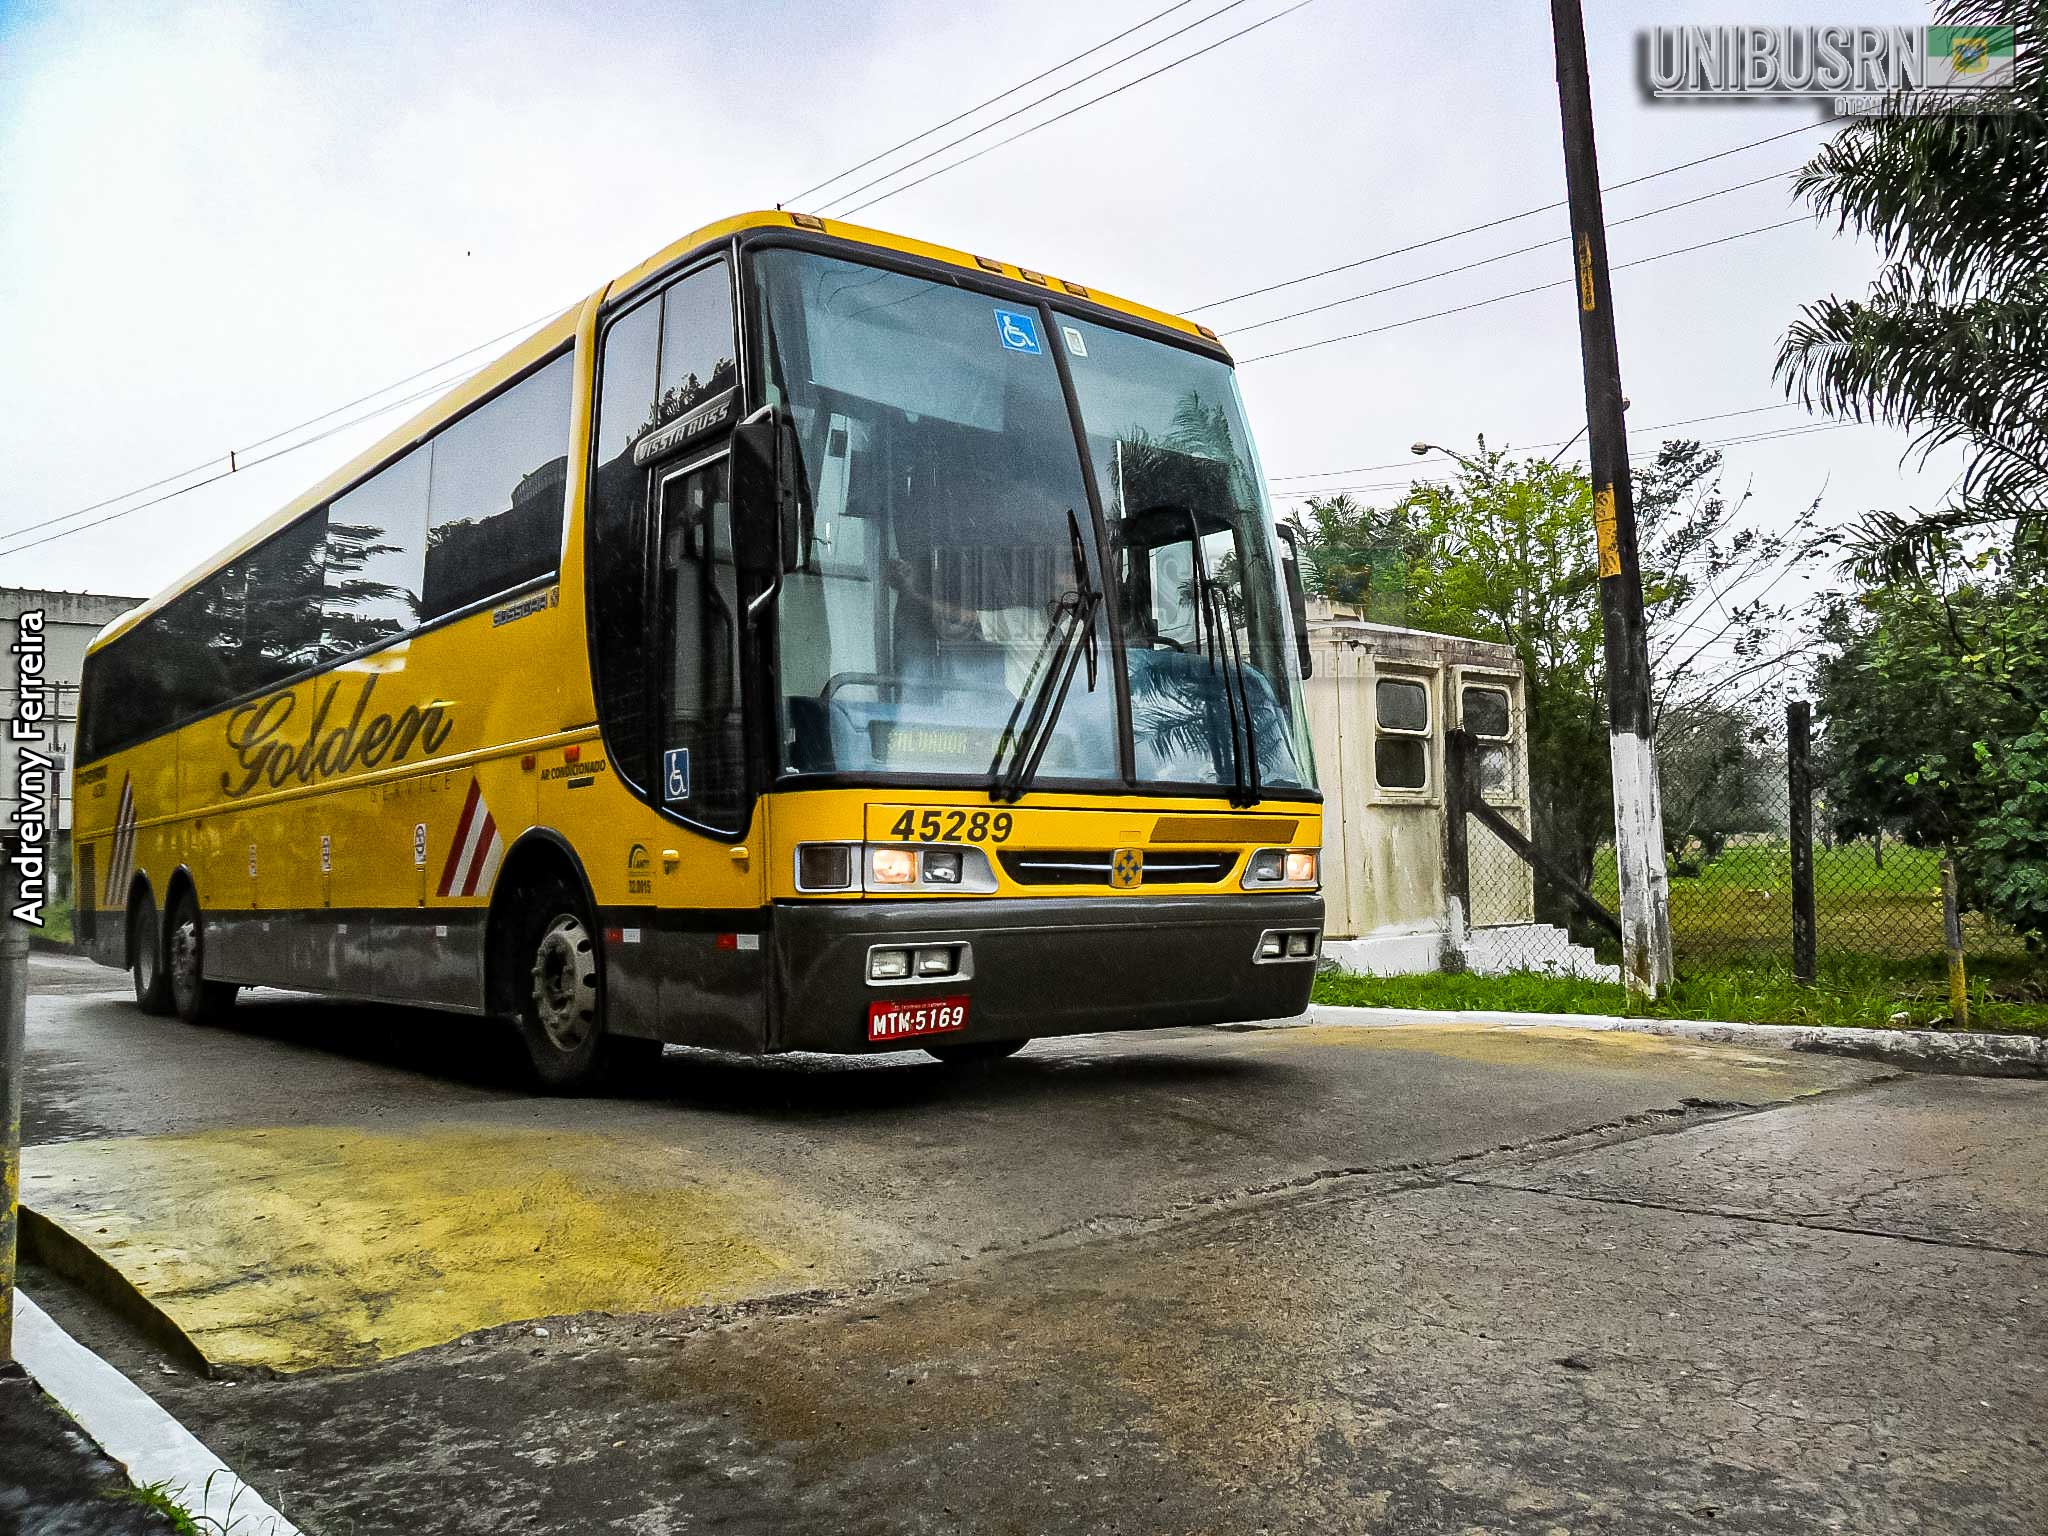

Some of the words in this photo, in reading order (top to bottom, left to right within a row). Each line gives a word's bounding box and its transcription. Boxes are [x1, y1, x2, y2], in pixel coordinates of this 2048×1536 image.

[220, 673, 454, 798] Golden
[551, 760, 606, 779] CONDICIONADO
[890, 810, 1013, 842] 45289
